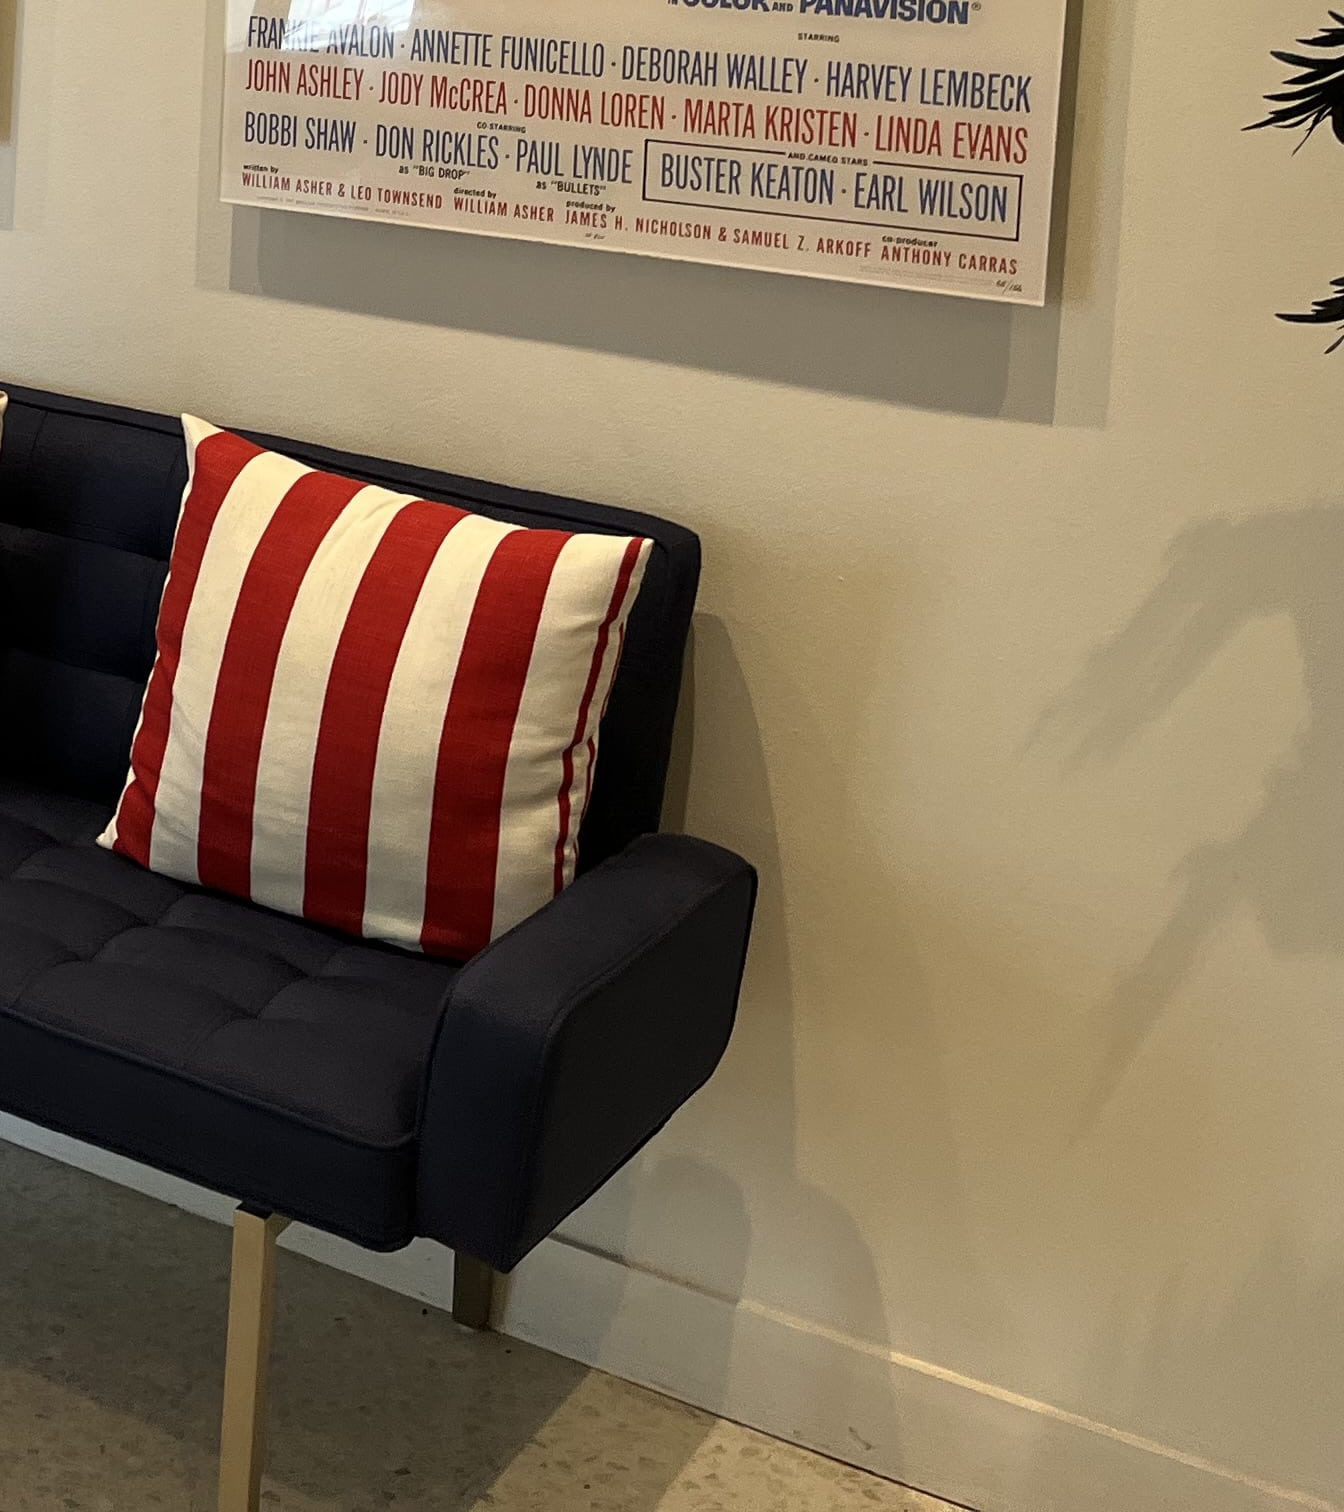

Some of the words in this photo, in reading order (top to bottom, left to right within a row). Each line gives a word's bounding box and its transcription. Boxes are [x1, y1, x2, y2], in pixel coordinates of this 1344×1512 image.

[772, 2, 793, 12] AND
[797, 32, 840, 43] STARRING
[326, 24, 394, 58] AVALON
[411, 28, 492, 68] ANNETTE
[500, 36, 605, 78] FUNICELLO
[621, 45, 718, 87] DEBORAH
[726, 53, 808, 94] WALLEY
[826, 61, 912, 102] HARVEY
[919, 68, 1032, 114] LEMBECK
[246, 59, 290, 94] JOHN
[296, 64, 364, 101] ASHLEY
[379, 70, 424, 107] JODY
[430, 75, 508, 115] McCREA
[524, 84, 592, 124] DONNA
[600, 91, 665, 130] LOREN
[684, 98, 756, 139] MARTA
[765, 105, 857, 148] KRISTEN
[875, 115, 942, 157] LINDA
[953, 121, 1028, 164] EVANS
[243, 164, 268, 174] written
[244, 111, 297, 148] BOBBI
[305, 116, 356, 154] SHAW
[375, 124, 414, 161] DON
[422, 129, 499, 170] RICKLES
[516, 138, 565, 177] PAUL
[572, 144, 634, 185] LYNDE
[661, 153, 742, 195] BUSTER
[751, 161, 834, 206] KEATON
[854, 171, 908, 213] EARL
[918, 178, 1008, 222] WILSON
[242, 172, 291, 192] WILLIAM
[296, 179, 333, 196] ASHER
[351, 185, 372, 201] LEO
[377, 187, 442, 209] TOWNSEND
[454, 187, 485, 198] directed
[453, 197, 508, 216] WILLIAM
[513, 204, 554, 222] ASHER
[565, 200, 603, 211] produced
[565, 210, 607, 229] JAMES
[614, 216, 629, 231] H.
[635, 218, 711, 240] NICHOLSON
[733, 228, 789, 250] SAMUEL
[797, 235, 810, 251] Z.
[816, 239, 872, 258] ARKOFF
[881, 245, 952, 267] ANTHONY
[958, 254, 1018, 275] CARRAS
